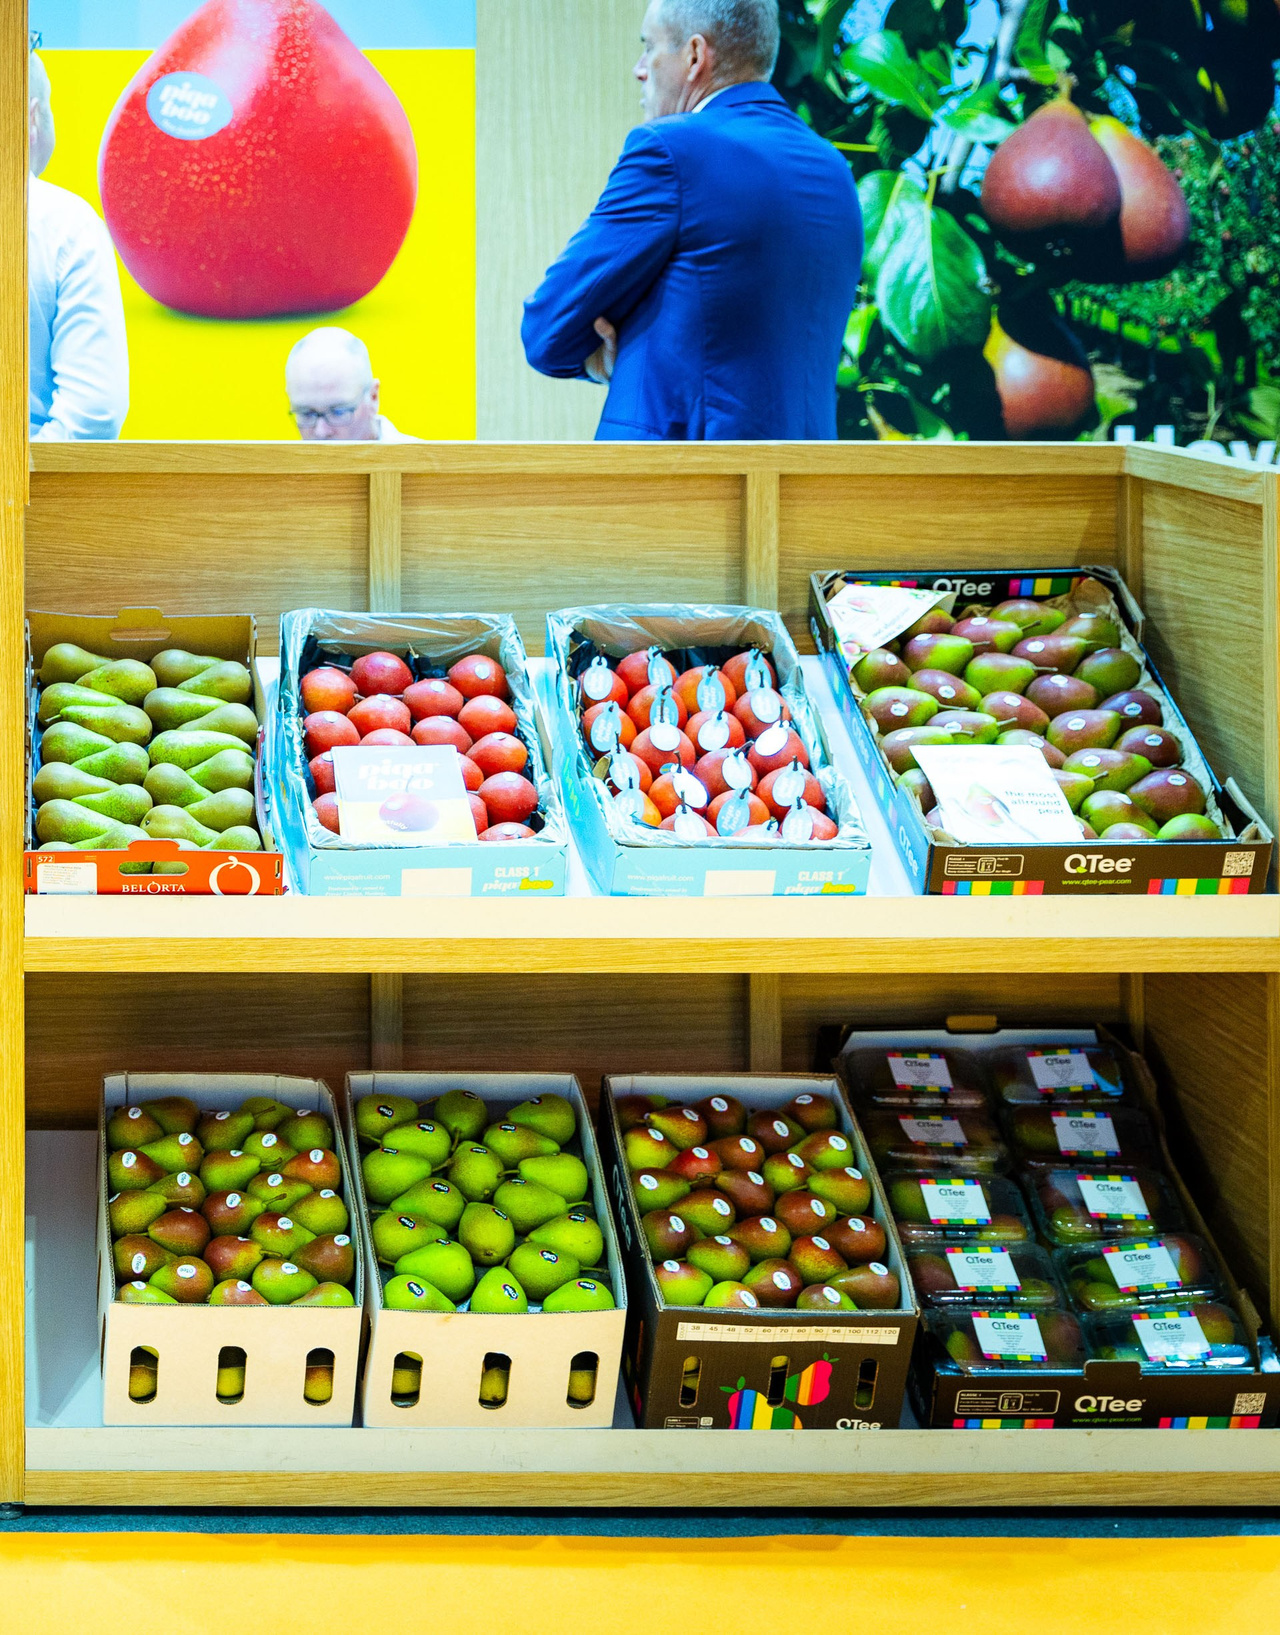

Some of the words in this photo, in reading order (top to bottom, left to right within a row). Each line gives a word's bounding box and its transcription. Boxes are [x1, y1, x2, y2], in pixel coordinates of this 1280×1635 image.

[37, 855, 54, 863] 572
[1064, 853, 1134, 874] QTee
[494, 866, 530, 878] CLASS
[798, 870, 834, 882] CLASS
[991, 1321, 1021, 1331] QTee
[1152, 1321, 1182, 1331] QTee
[1074, 1395, 1144, 1413] QTee
